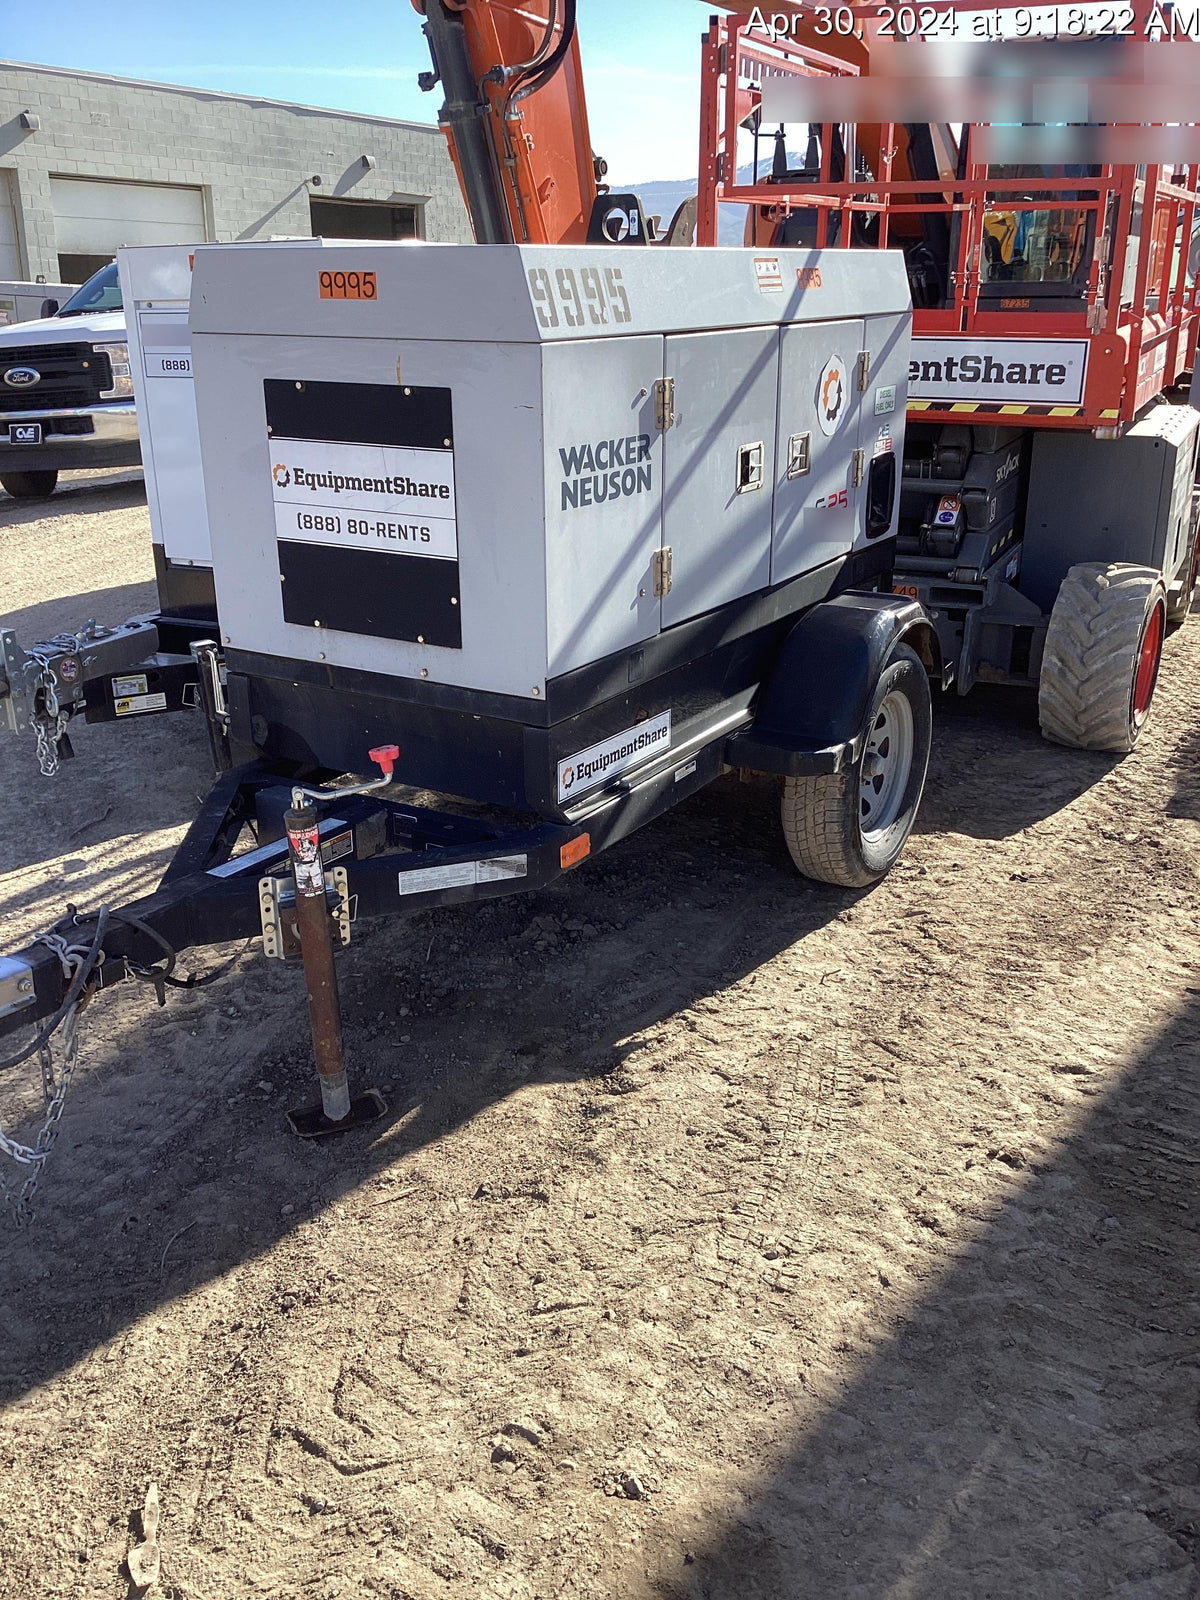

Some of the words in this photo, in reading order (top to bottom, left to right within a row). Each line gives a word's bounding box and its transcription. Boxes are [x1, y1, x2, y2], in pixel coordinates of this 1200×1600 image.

[320, 271, 375, 298] 9995
[528, 267, 632, 328] 9995
[12, 372, 30, 382] Ford
[161, 359, 190, 371] (888)
[558, 433, 652, 477] WACKER
[293, 467, 450, 499] EquipmentShare
[561, 463, 652, 511] NEUSON
[297, 512, 341, 534] (888)
[347, 518, 431, 543] 80-RENTS
[576, 725, 668, 780] EquipmentShare
